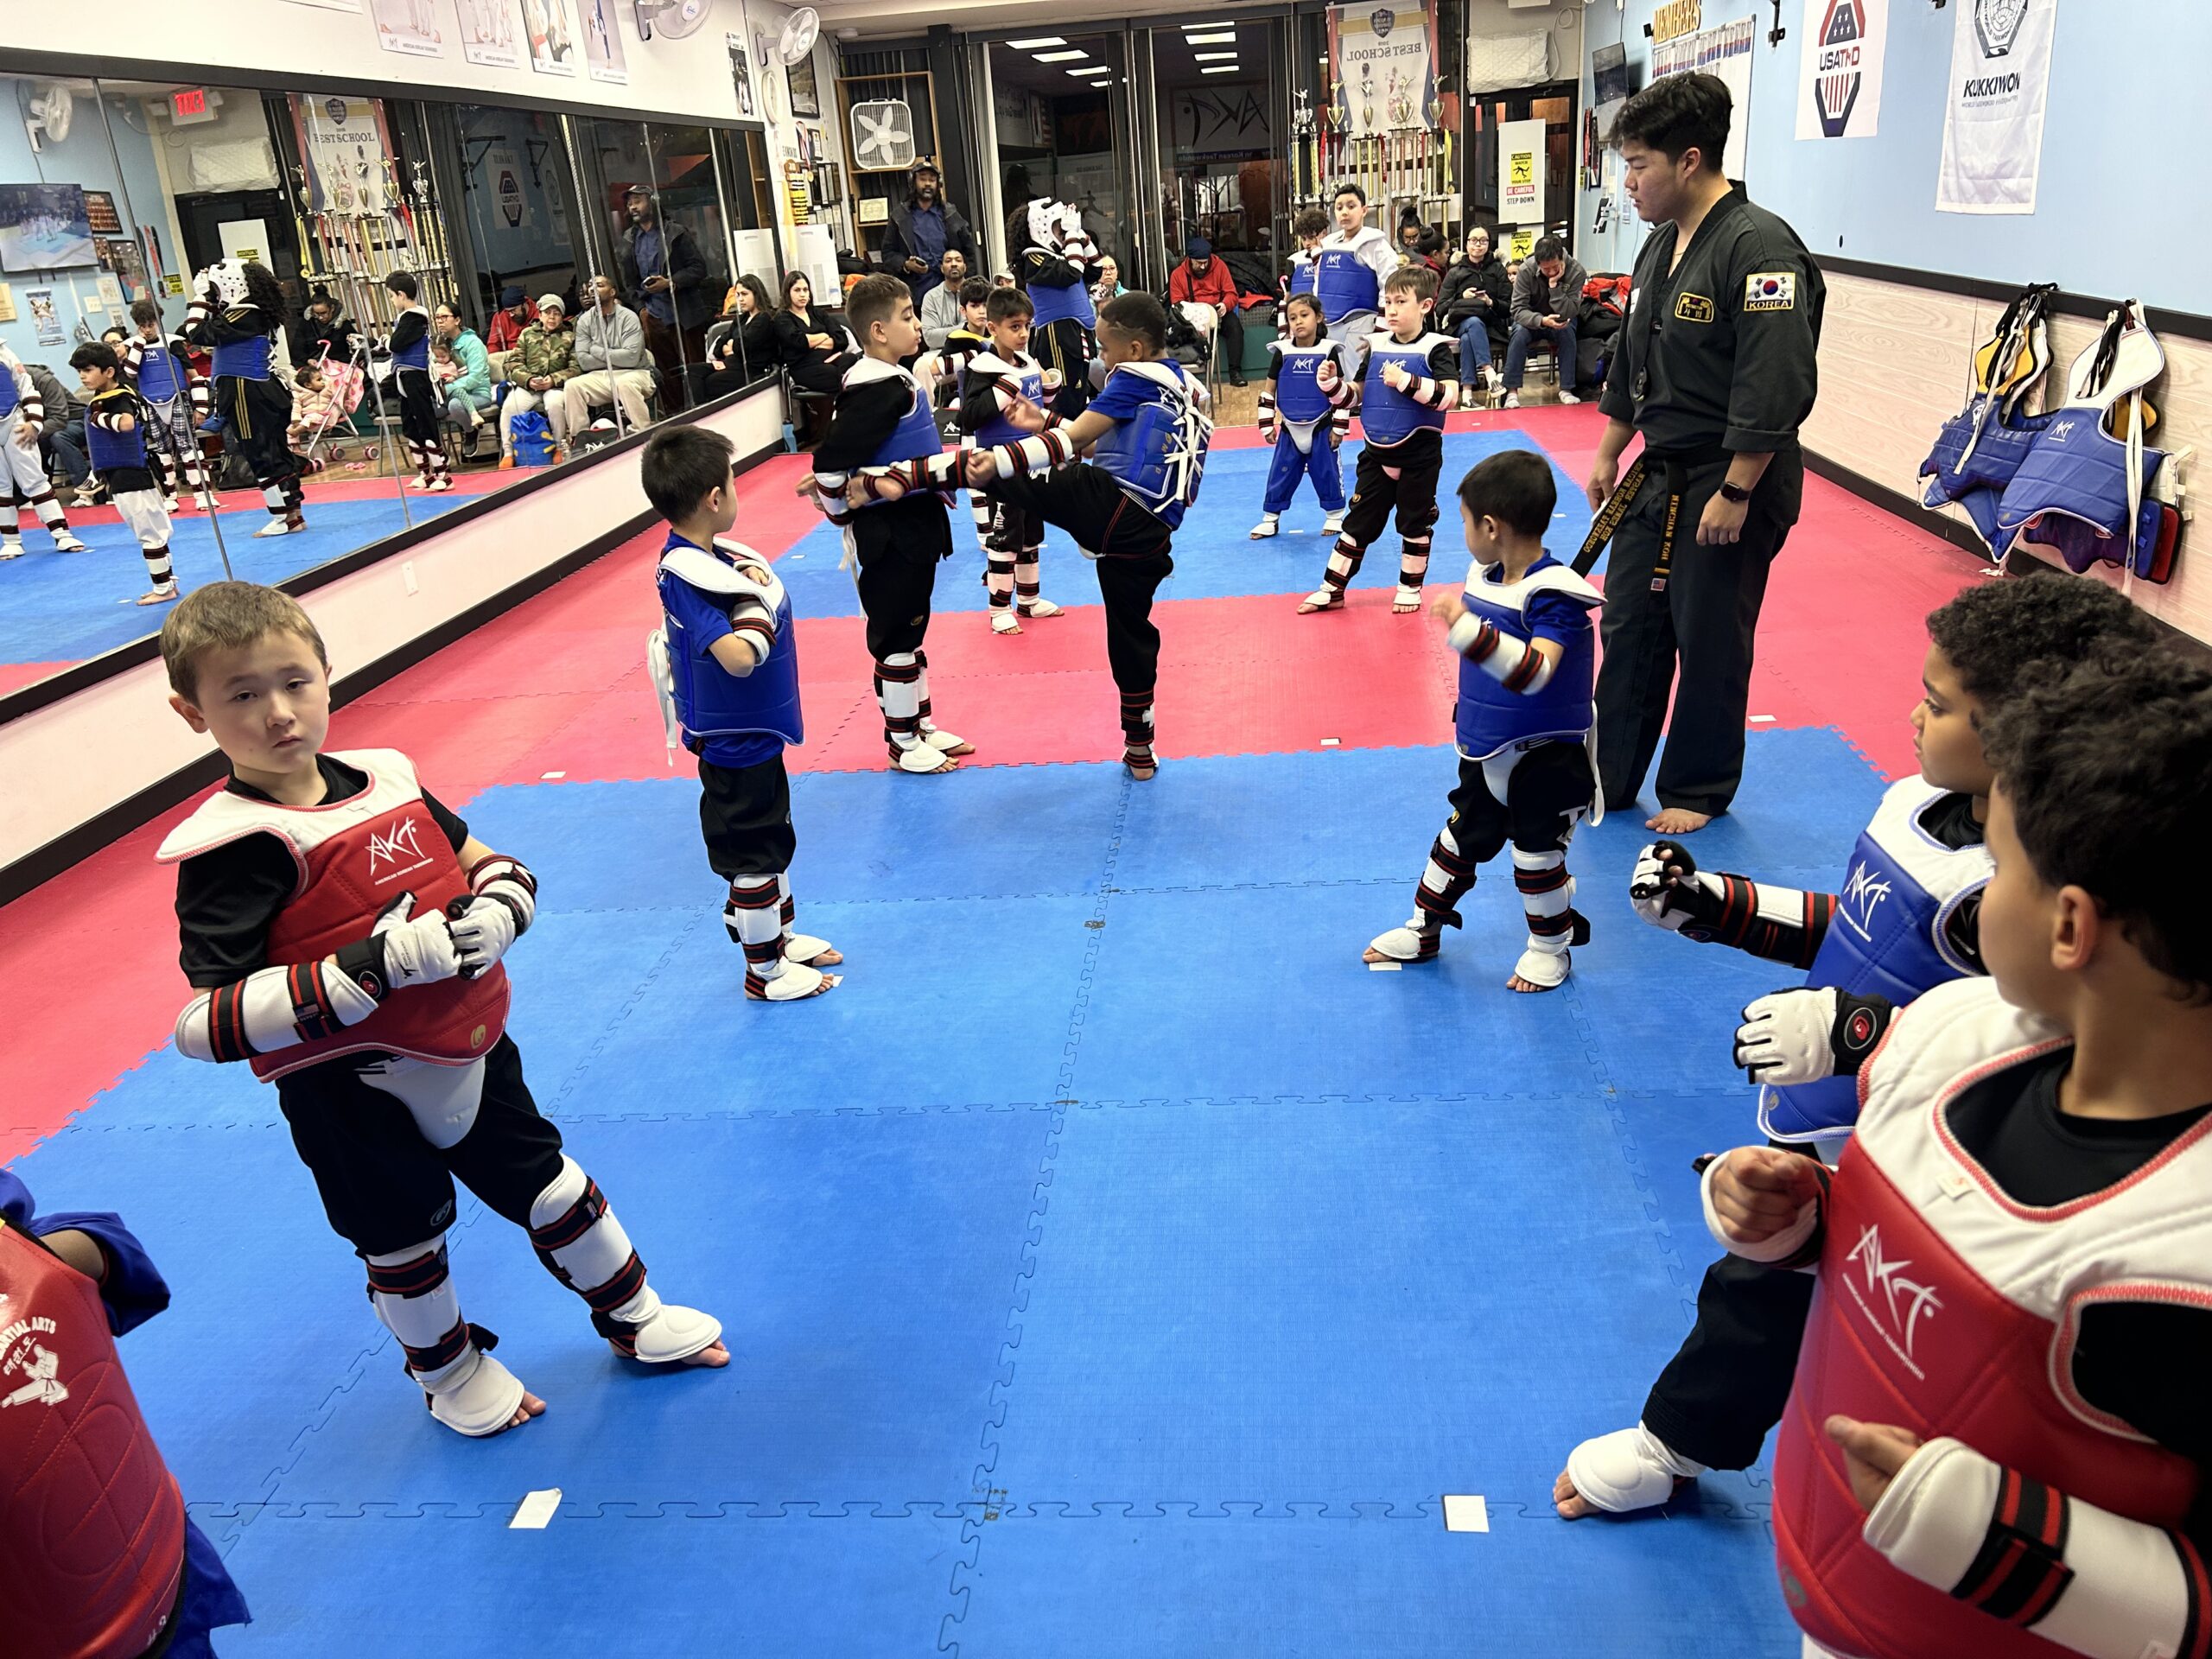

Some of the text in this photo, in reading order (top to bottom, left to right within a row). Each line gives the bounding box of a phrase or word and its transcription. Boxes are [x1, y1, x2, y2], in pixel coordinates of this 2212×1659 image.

[1653, 0, 1701, 45] MEMBERS
[1963, 71, 2022, 98] KUKKIWON
[336, 132, 375, 143] SCHOOL
[1507, 185, 1535, 195] BE CAREFUL
[1749, 301, 1789, 309] KOREA
[1661, 541, 1672, 561] KOH
[32, 1316, 56, 1334] ARTS
